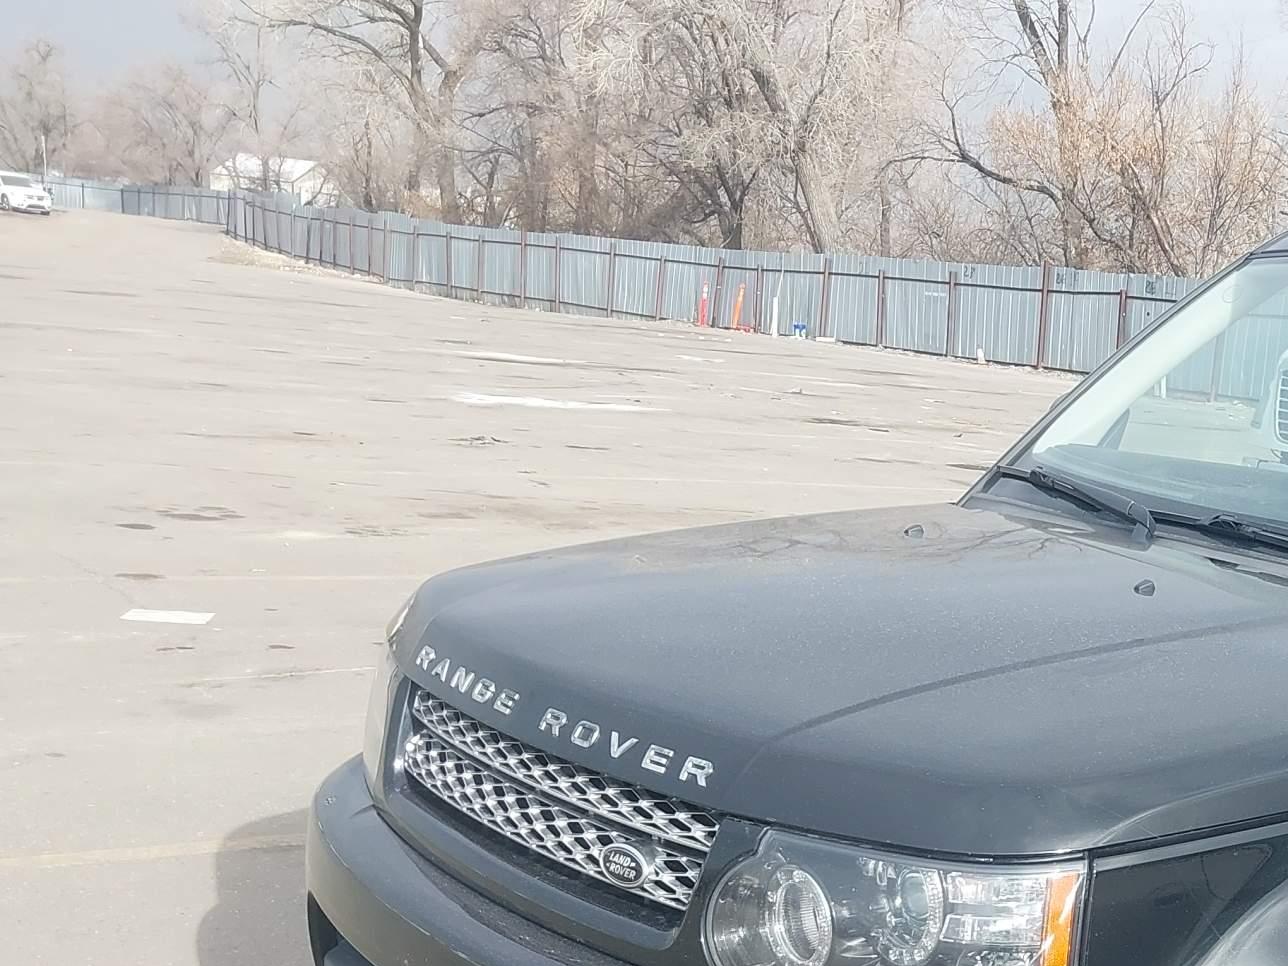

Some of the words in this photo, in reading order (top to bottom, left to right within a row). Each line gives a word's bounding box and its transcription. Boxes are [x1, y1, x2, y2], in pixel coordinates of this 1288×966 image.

[415, 645, 521, 715] RANGE
[538, 707, 715, 788] ROVER
[609, 851, 632, 867] LAND
[609, 862, 637, 880] ROVER
